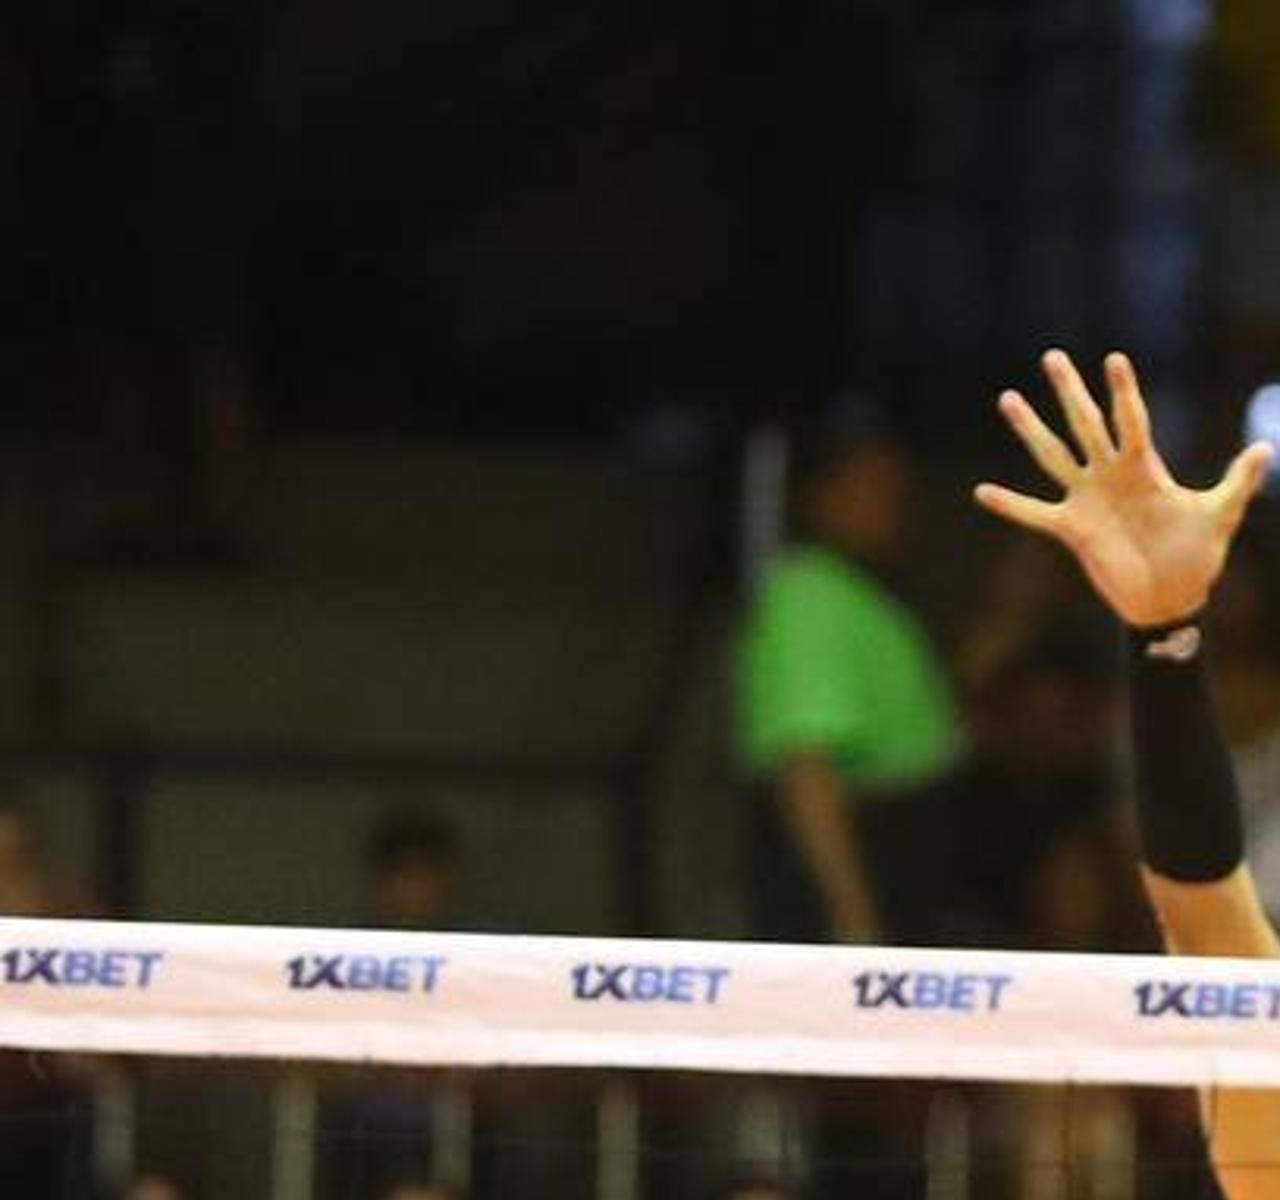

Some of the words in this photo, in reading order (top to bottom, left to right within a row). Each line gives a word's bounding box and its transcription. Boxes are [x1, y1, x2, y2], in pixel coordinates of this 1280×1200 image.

[3, 947, 163, 987] 1XBET
[286, 955, 446, 995] 1XBET
[570, 962, 729, 1004] 1XBET
[852, 970, 1012, 1012] 1XBET
